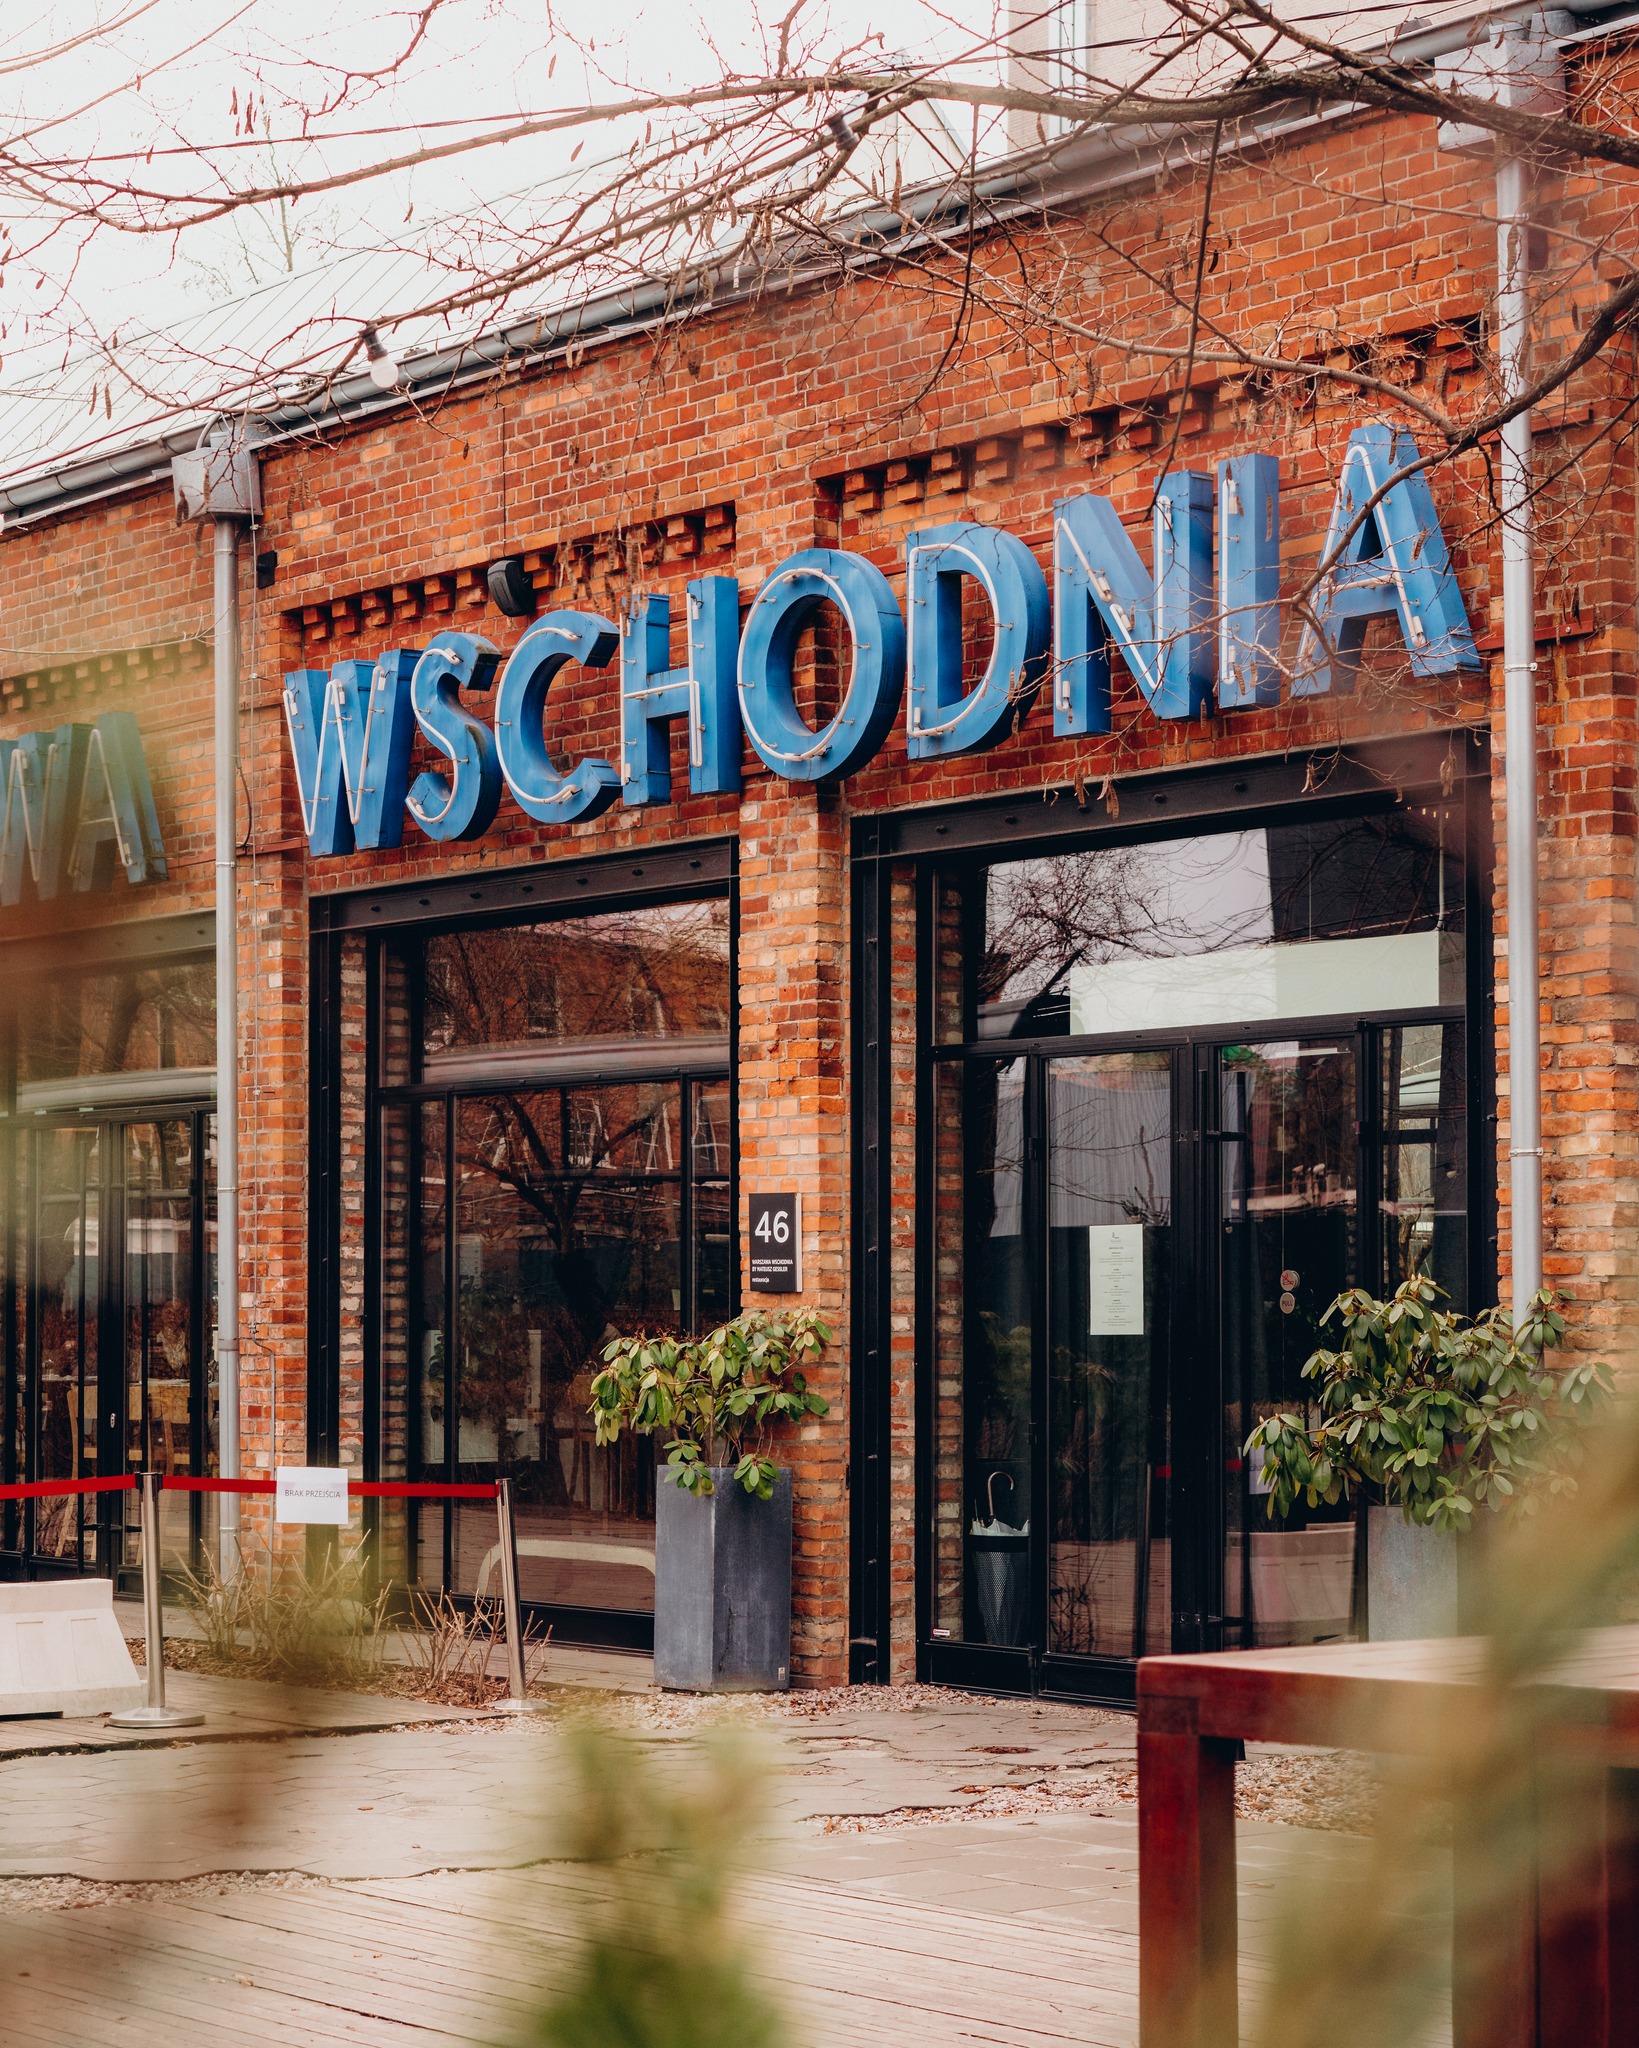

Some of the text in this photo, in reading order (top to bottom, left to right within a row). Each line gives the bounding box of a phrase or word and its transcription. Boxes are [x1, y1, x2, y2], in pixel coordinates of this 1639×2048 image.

[284, 424, 1483, 858] WSCHODNIA
[755, 1210, 789, 1243] 46
[284, 1489, 341, 1498] BRAK PRZEJŚCIA
